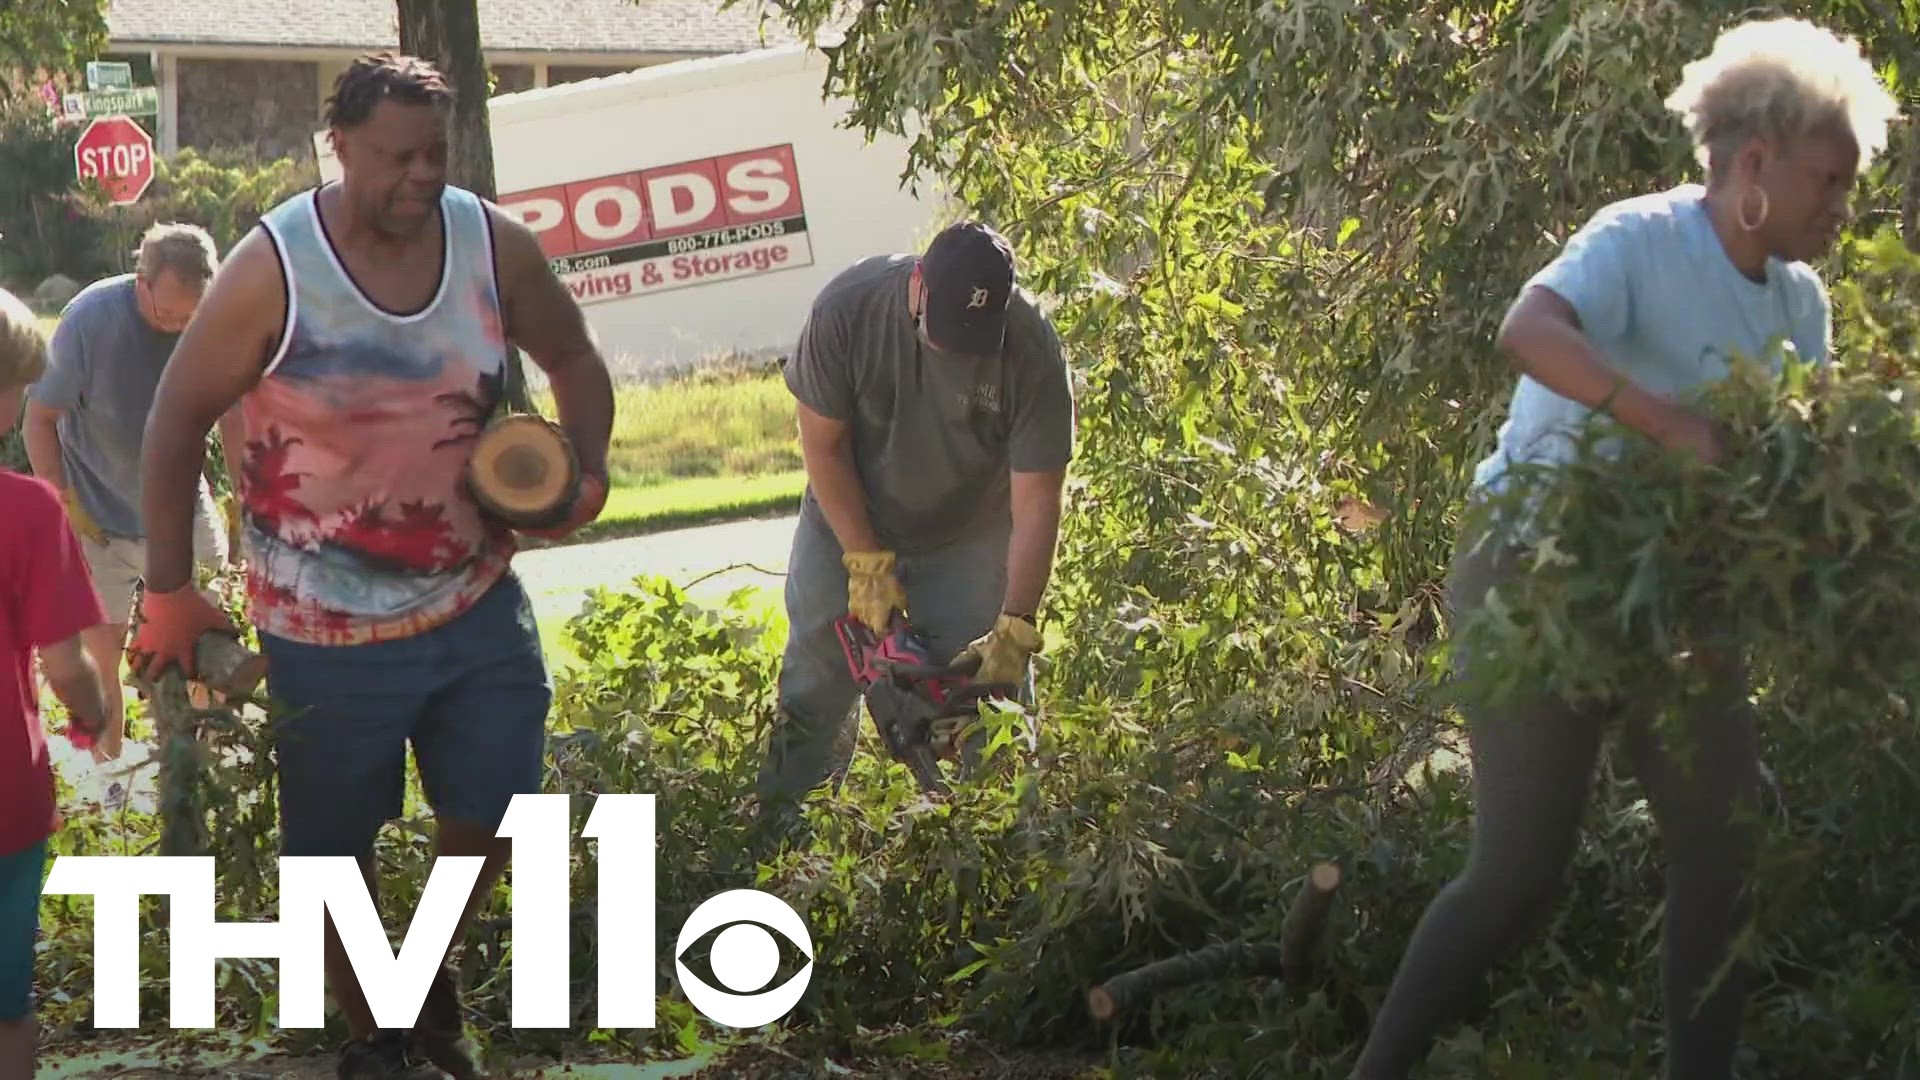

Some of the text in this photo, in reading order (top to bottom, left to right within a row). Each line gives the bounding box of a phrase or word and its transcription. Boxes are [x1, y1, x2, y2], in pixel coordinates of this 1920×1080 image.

[82, 143, 147, 178] STOP
[506, 158, 791, 240] PODS
[667, 220, 785, 254] 800-776-PODS
[641, 262, 665, 287] &
[672, 244, 789, 280] Storage
